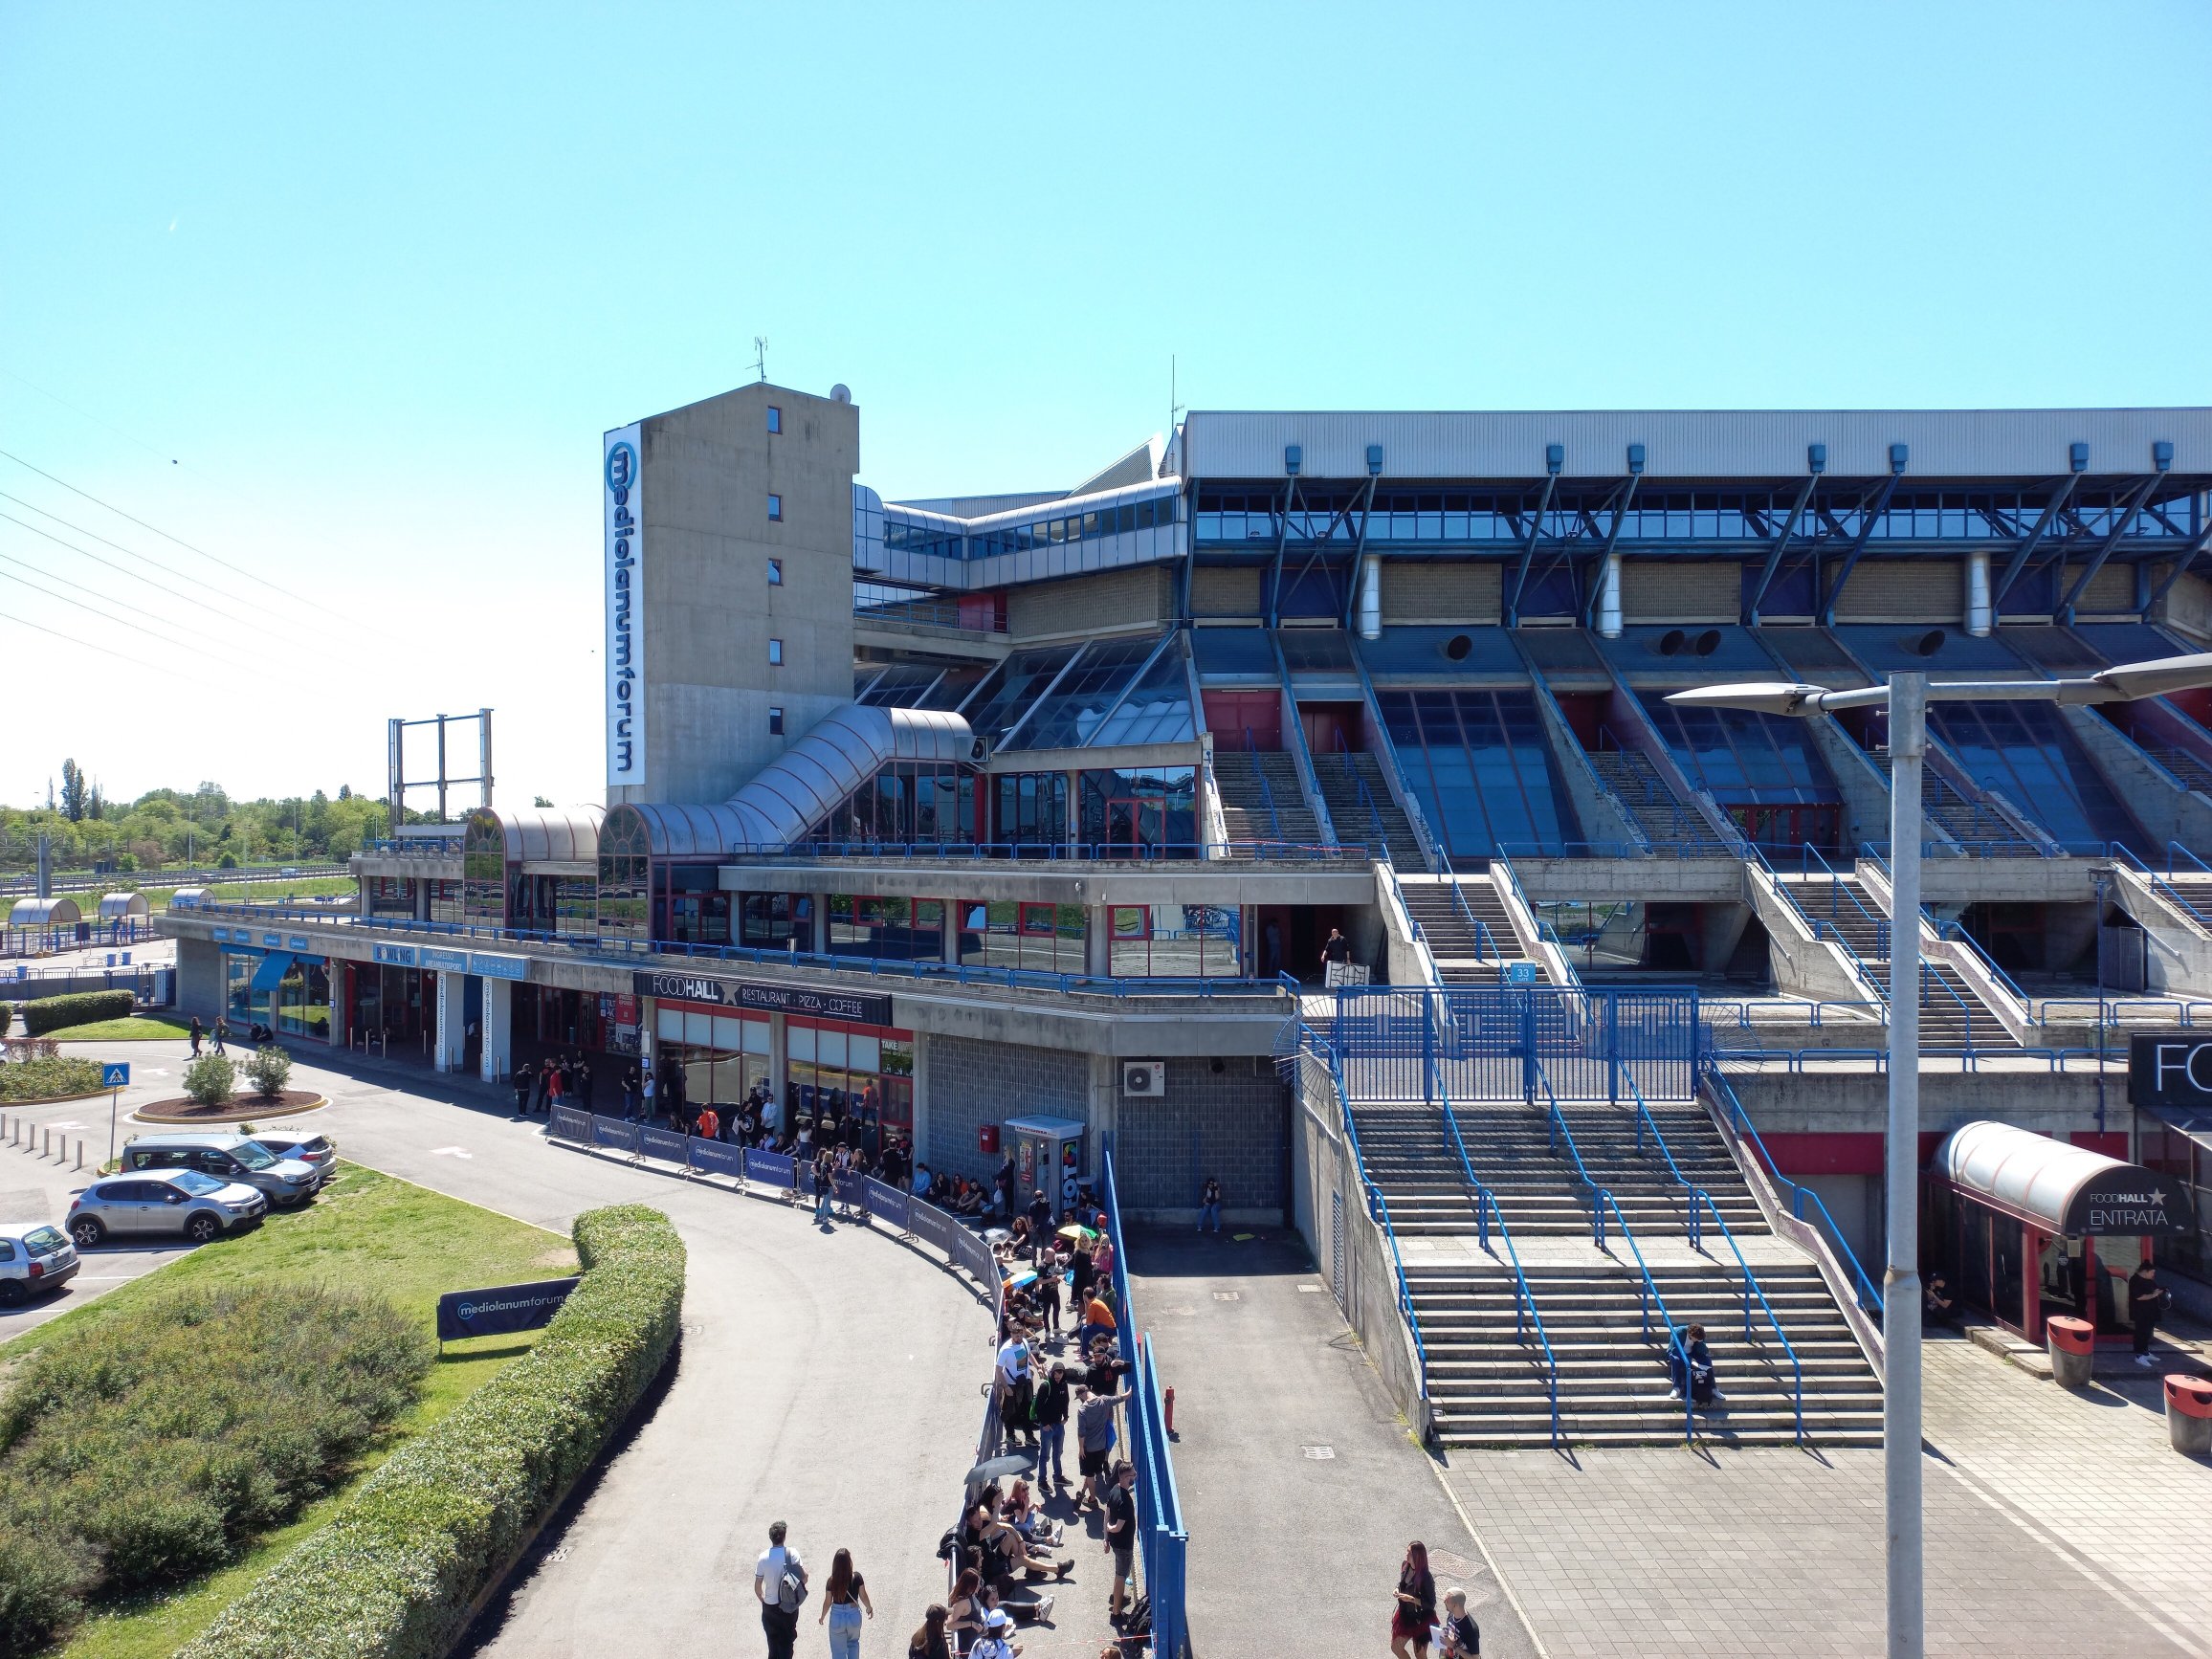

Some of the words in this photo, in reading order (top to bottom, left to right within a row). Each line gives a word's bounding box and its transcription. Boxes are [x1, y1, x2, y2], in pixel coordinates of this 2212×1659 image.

[609, 446, 636, 772] mediolanumforum
[377, 946, 410, 963] BOWLING
[1517, 968, 1529, 977] 33
[653, 976, 719, 1000] FOODHALL
[742, 987, 790, 1005] RESTAURANT
[799, 995, 822, 1008] PIZZA
[829, 998, 862, 1014] COFFEE
[881, 1040, 898, 1051] TAKE
[2090, 1193, 2148, 1204] FOODHALL
[2090, 1209, 2169, 1226] ENTRATA
[459, 1295, 564, 1318] mediolanumforum
